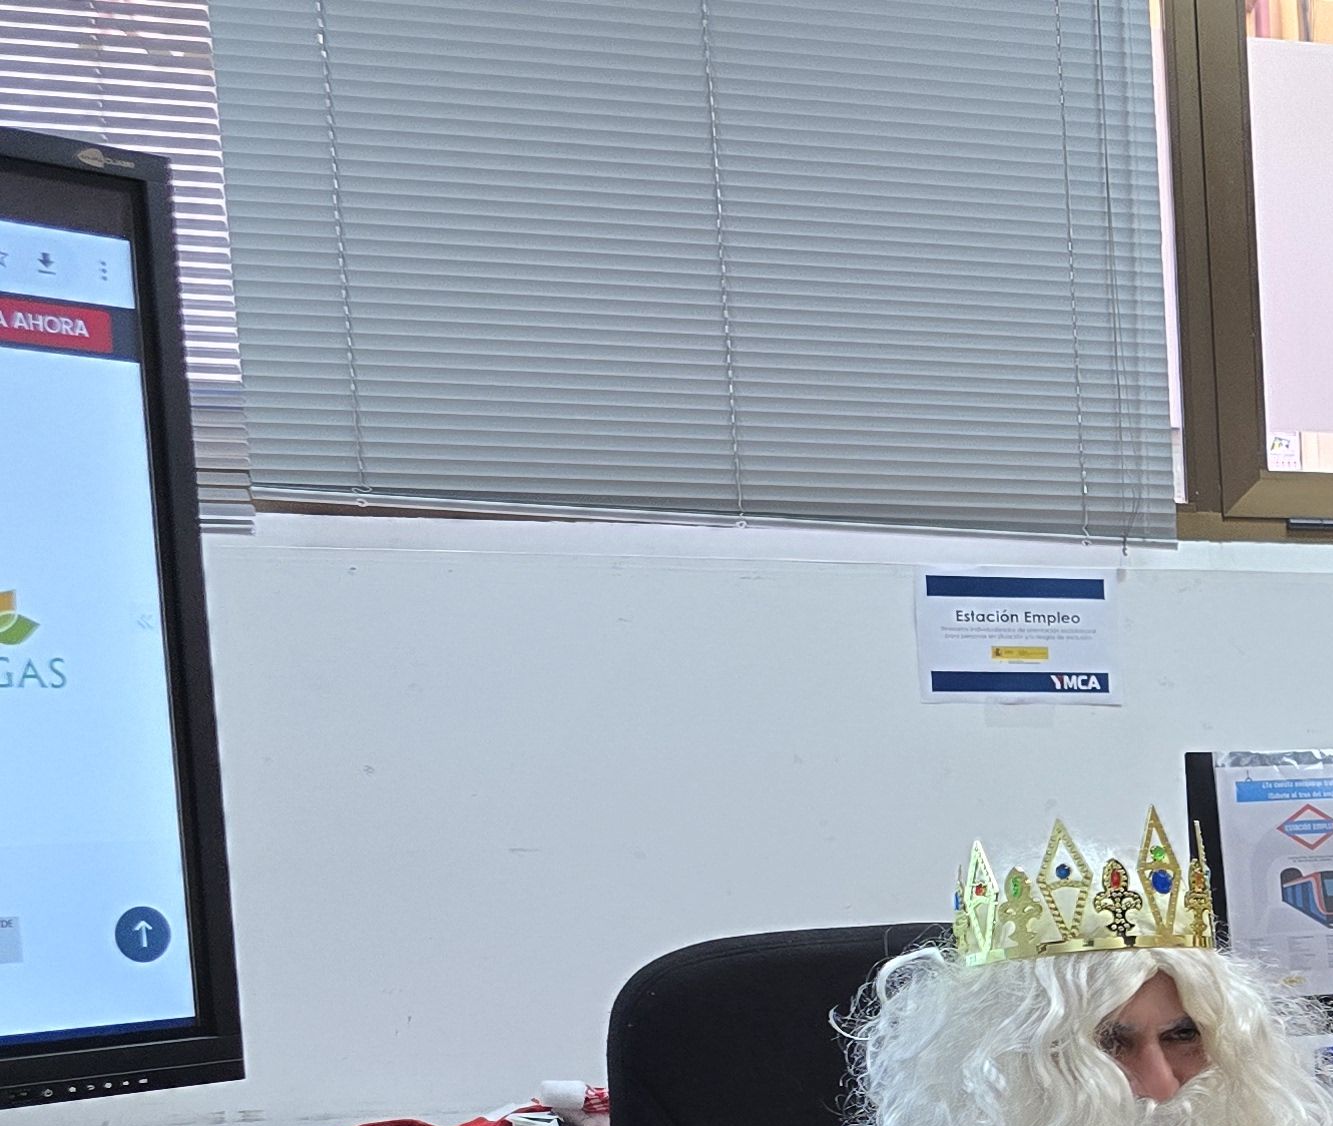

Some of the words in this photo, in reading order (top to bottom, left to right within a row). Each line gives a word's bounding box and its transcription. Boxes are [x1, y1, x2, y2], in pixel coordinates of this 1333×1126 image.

[13, 311, 90, 338] AHORA
[956, 609, 1019, 624] Estación
[1024, 611, 1081, 627] Empleo
[1050, 674, 1101, 691] YMCA
